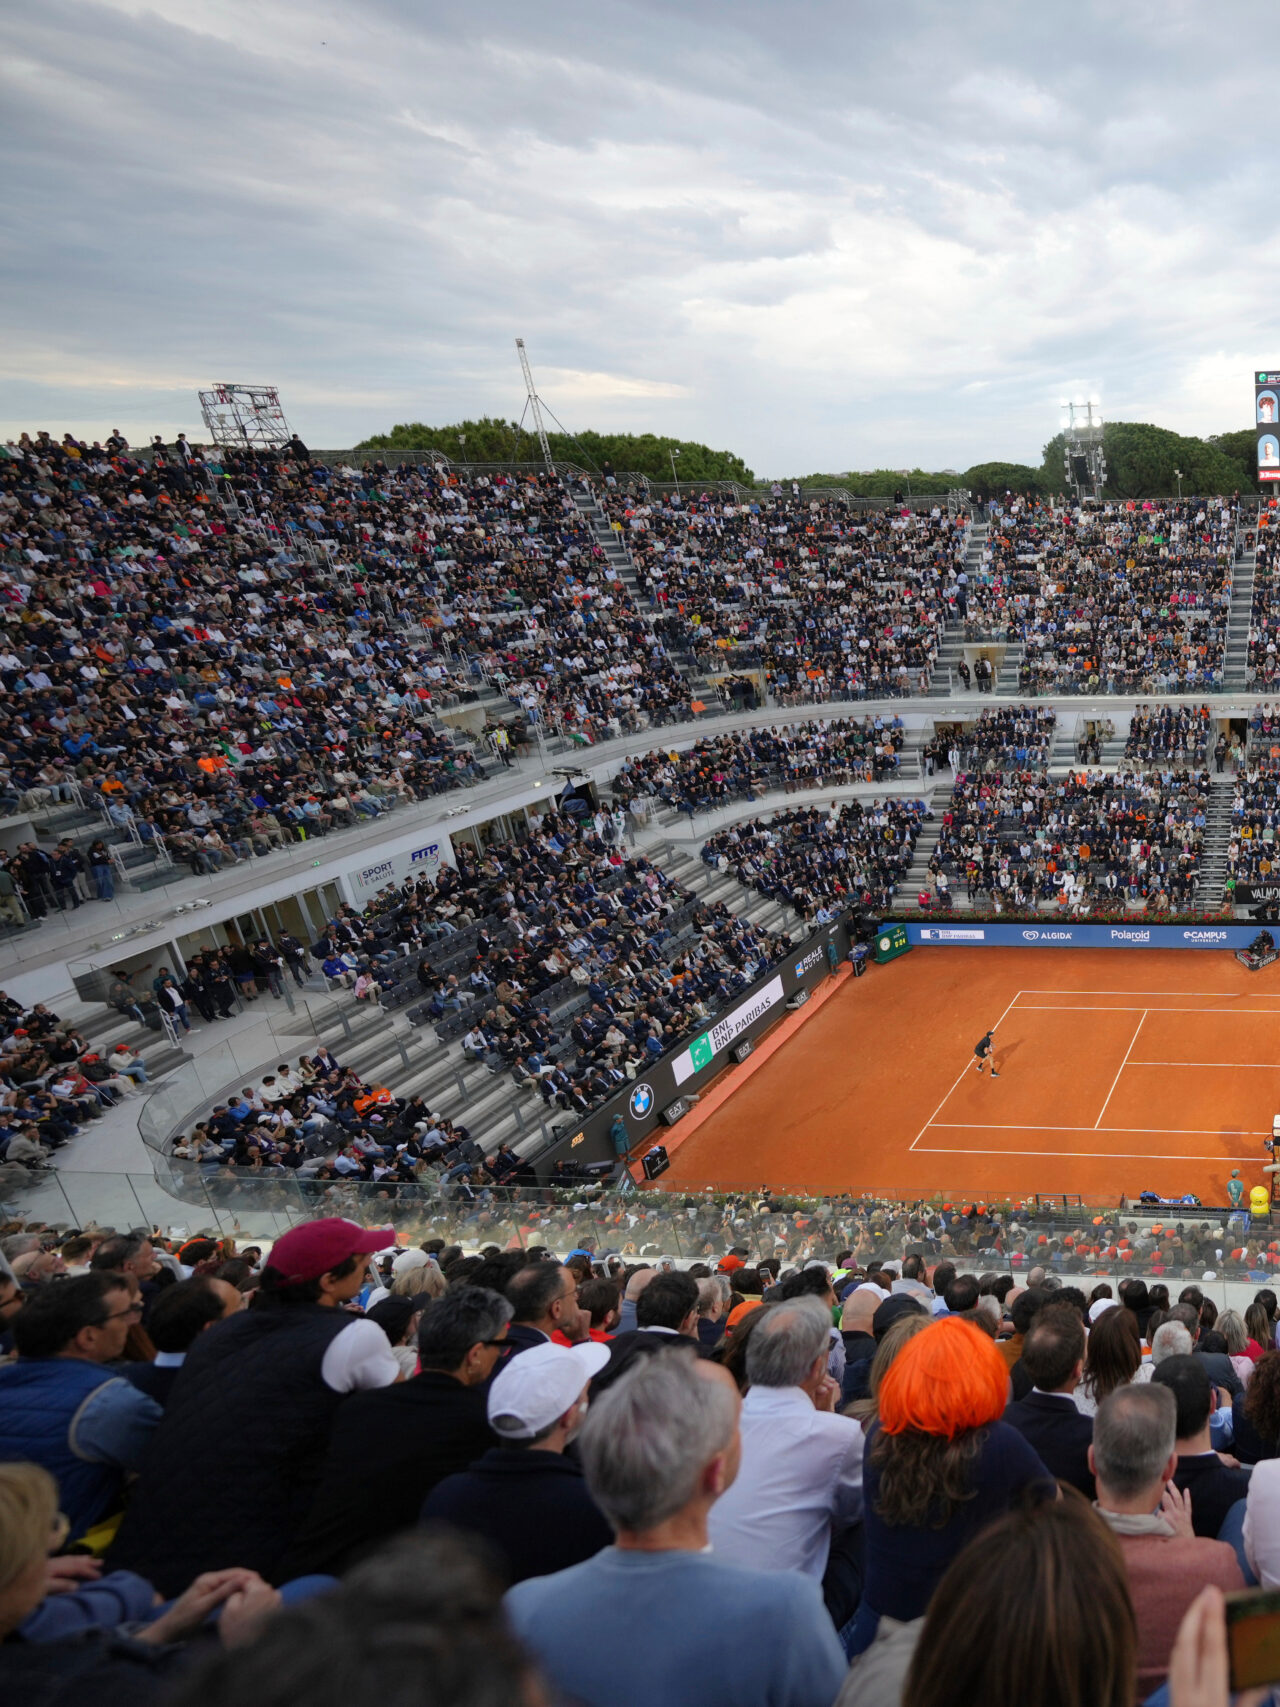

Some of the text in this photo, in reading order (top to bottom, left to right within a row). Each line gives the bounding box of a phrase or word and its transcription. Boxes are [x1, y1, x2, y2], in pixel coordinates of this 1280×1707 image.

[362, 861, 392, 879] SPORT
[371, 870, 394, 883] SALUTE
[1111, 930, 1150, 939] Polaroid
[803, 946, 822, 966] REALE
[804, 954, 824, 971] MUTUA
[796, 992, 808, 1003] EA7
[712, 1020, 732, 1040] BNL
[714, 996, 771, 1050] BNP PARIBAS
[738, 1042, 750, 1057] EA7
[668, 1102, 683, 1118] EA7
